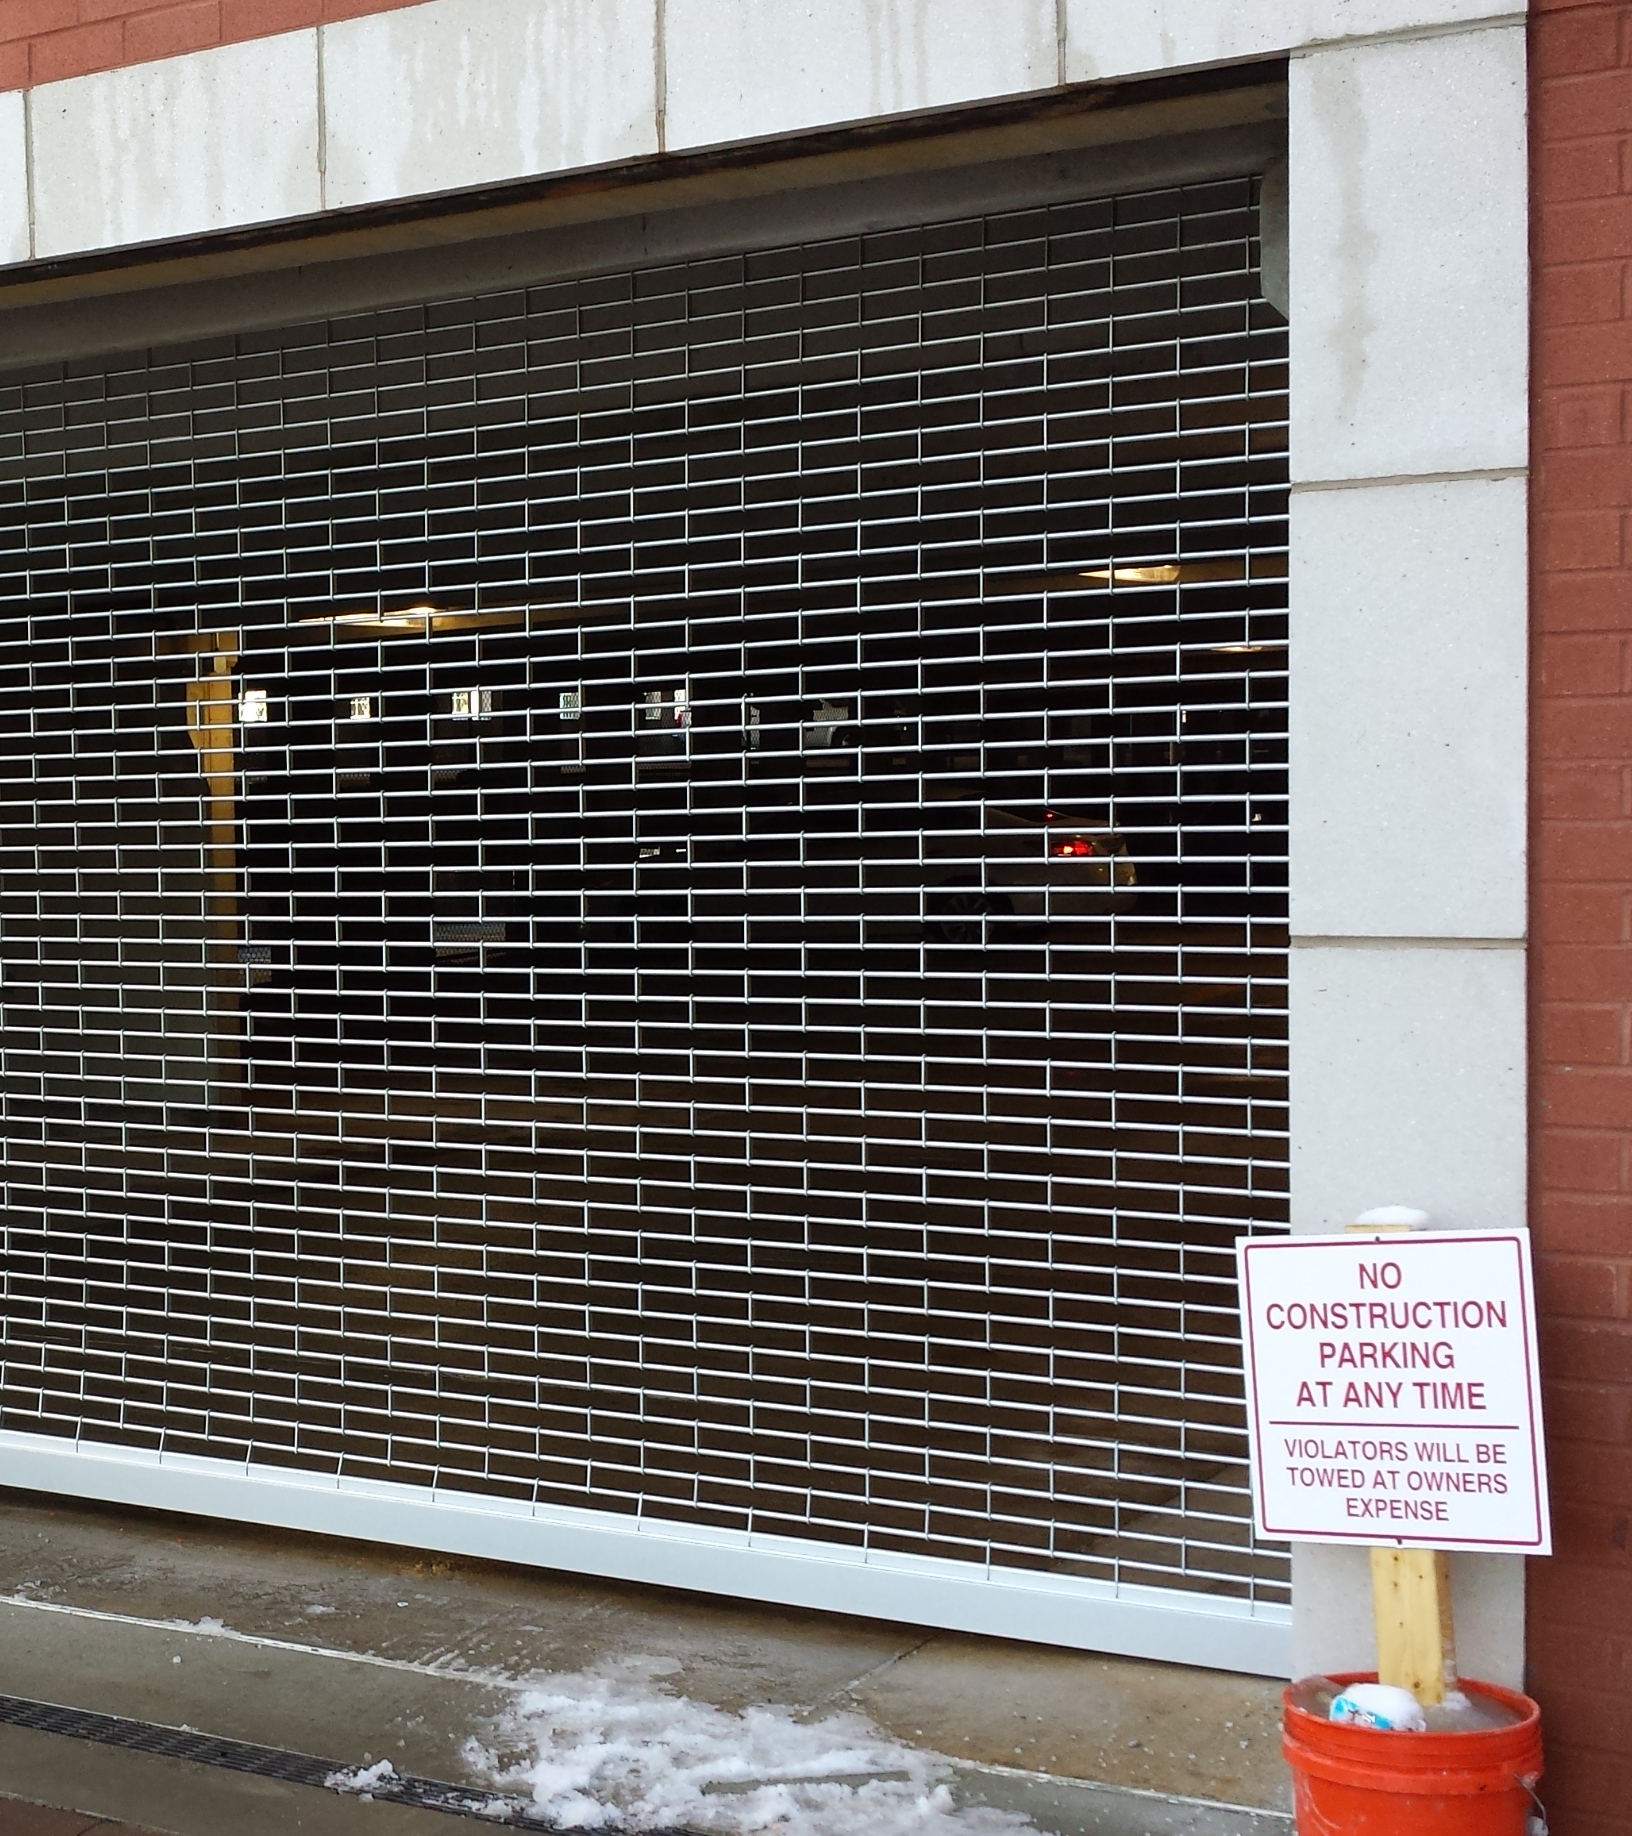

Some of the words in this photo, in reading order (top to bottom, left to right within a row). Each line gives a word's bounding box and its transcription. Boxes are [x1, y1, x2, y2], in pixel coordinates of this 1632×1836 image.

[1358, 1261, 1402, 1290] NO
[1266, 1300, 1508, 1330] CONSTRUCTION
[1319, 1341, 1455, 1370] PARKING
[1296, 1380, 1334, 1408] AT
[1342, 1381, 1404, 1409] ANY
[1411, 1381, 1487, 1410] TIME
[1283, 1438, 1409, 1462] VIOLATORS
[1414, 1441, 1470, 1464] WILL
[1475, 1443, 1507, 1465] BE
[1285, 1466, 1366, 1489] TOWED
[1372, 1469, 1401, 1490] AT
[1406, 1471, 1508, 1495] OWNERS
[1345, 1497, 1450, 1522] EXPENSE
